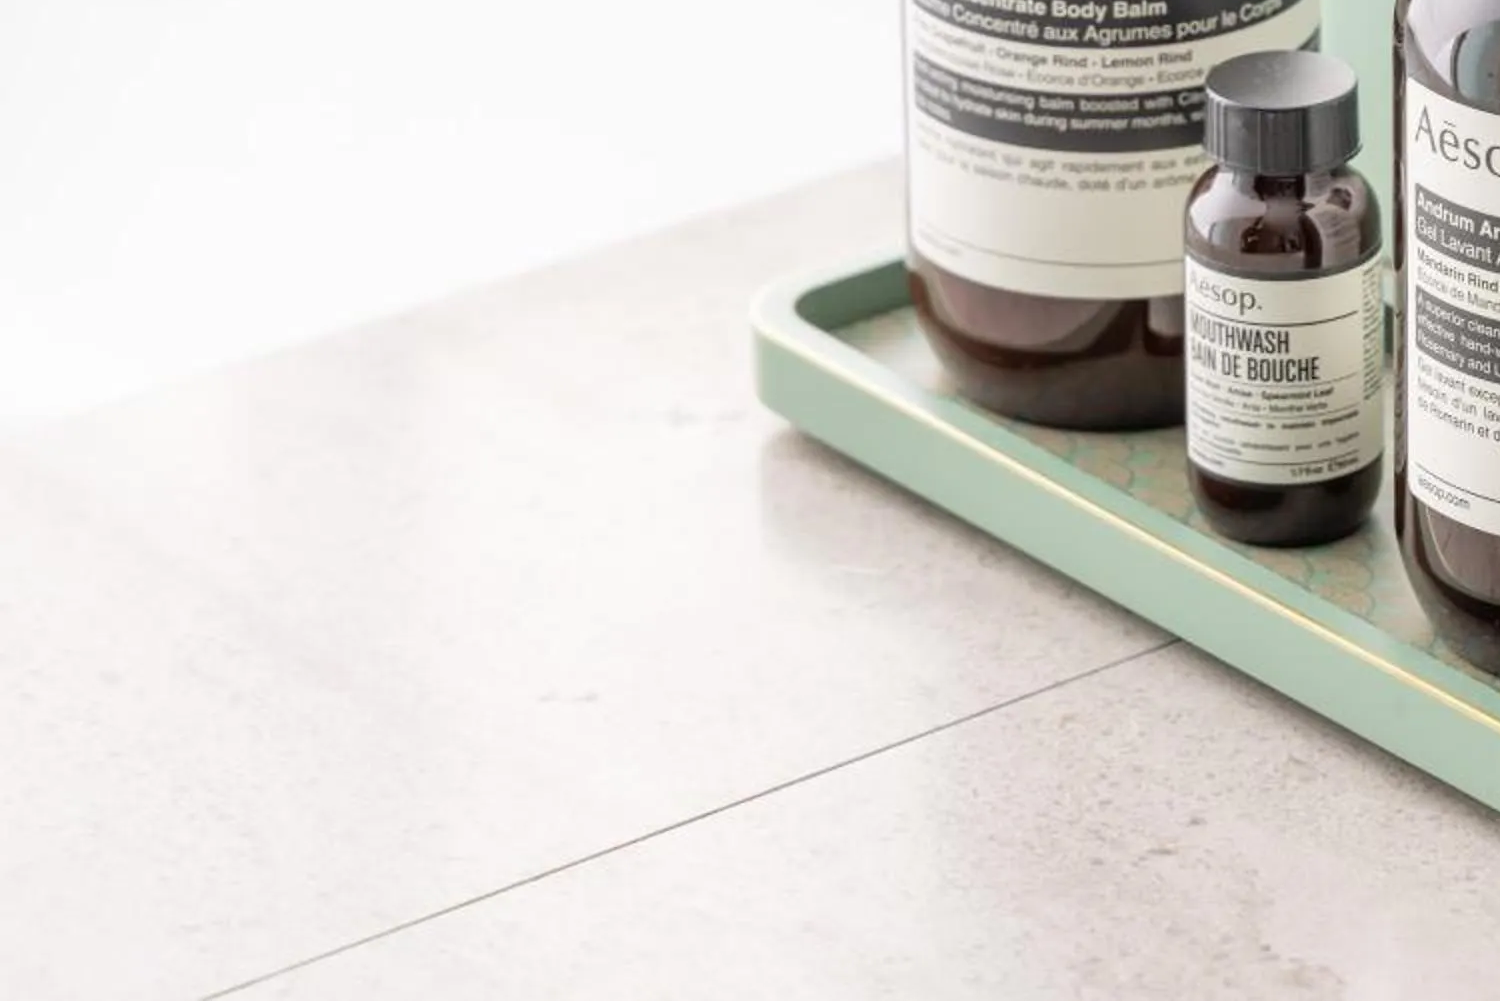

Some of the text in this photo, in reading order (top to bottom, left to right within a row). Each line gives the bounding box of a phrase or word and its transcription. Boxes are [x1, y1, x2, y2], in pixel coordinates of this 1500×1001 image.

[953, 1, 1039, 39] Concentré
[1043, 25, 1079, 41] aux
[1083, 24, 1173, 47] Agrumes
[1176, 15, 1219, 40] pour
[1221, 9, 1238, 27] le
[1051, 0, 1107, 24] Body
[1113, 0, 1168, 19] Balm
[995, 46, 1047, 67] Orange
[1052, 54, 1089, 69] Rind
[1101, 56, 1154, 69] Lemon
[1157, 49, 1193, 64] Rind
[1039, 96, 1075, 110] balm
[1080, 98, 1139, 112] boosted
[1143, 95, 1174, 109] with
[1024, 112, 1067, 131] during
[1070, 118, 1128, 130] summer
[1417, 191, 1475, 233] Andrum
[1416, 215, 1438, 242] Gel
[1440, 229, 1493, 264] Lavant
[1417, 246, 1465, 283] Mandarin
[1467, 271, 1499, 293] Rind
[1449, 285, 1465, 302] de
[1192, 311, 1290, 354] MOUTHWASH
[1417, 330, 1465, 369] Rosemary
[1467, 359, 1491, 375] and
[1221, 351, 1242, 378] DE
[1247, 356, 1320, 383] BOUCHE
[1450, 395, 1478, 418] d'un
[1477, 424, 1490, 439] et
